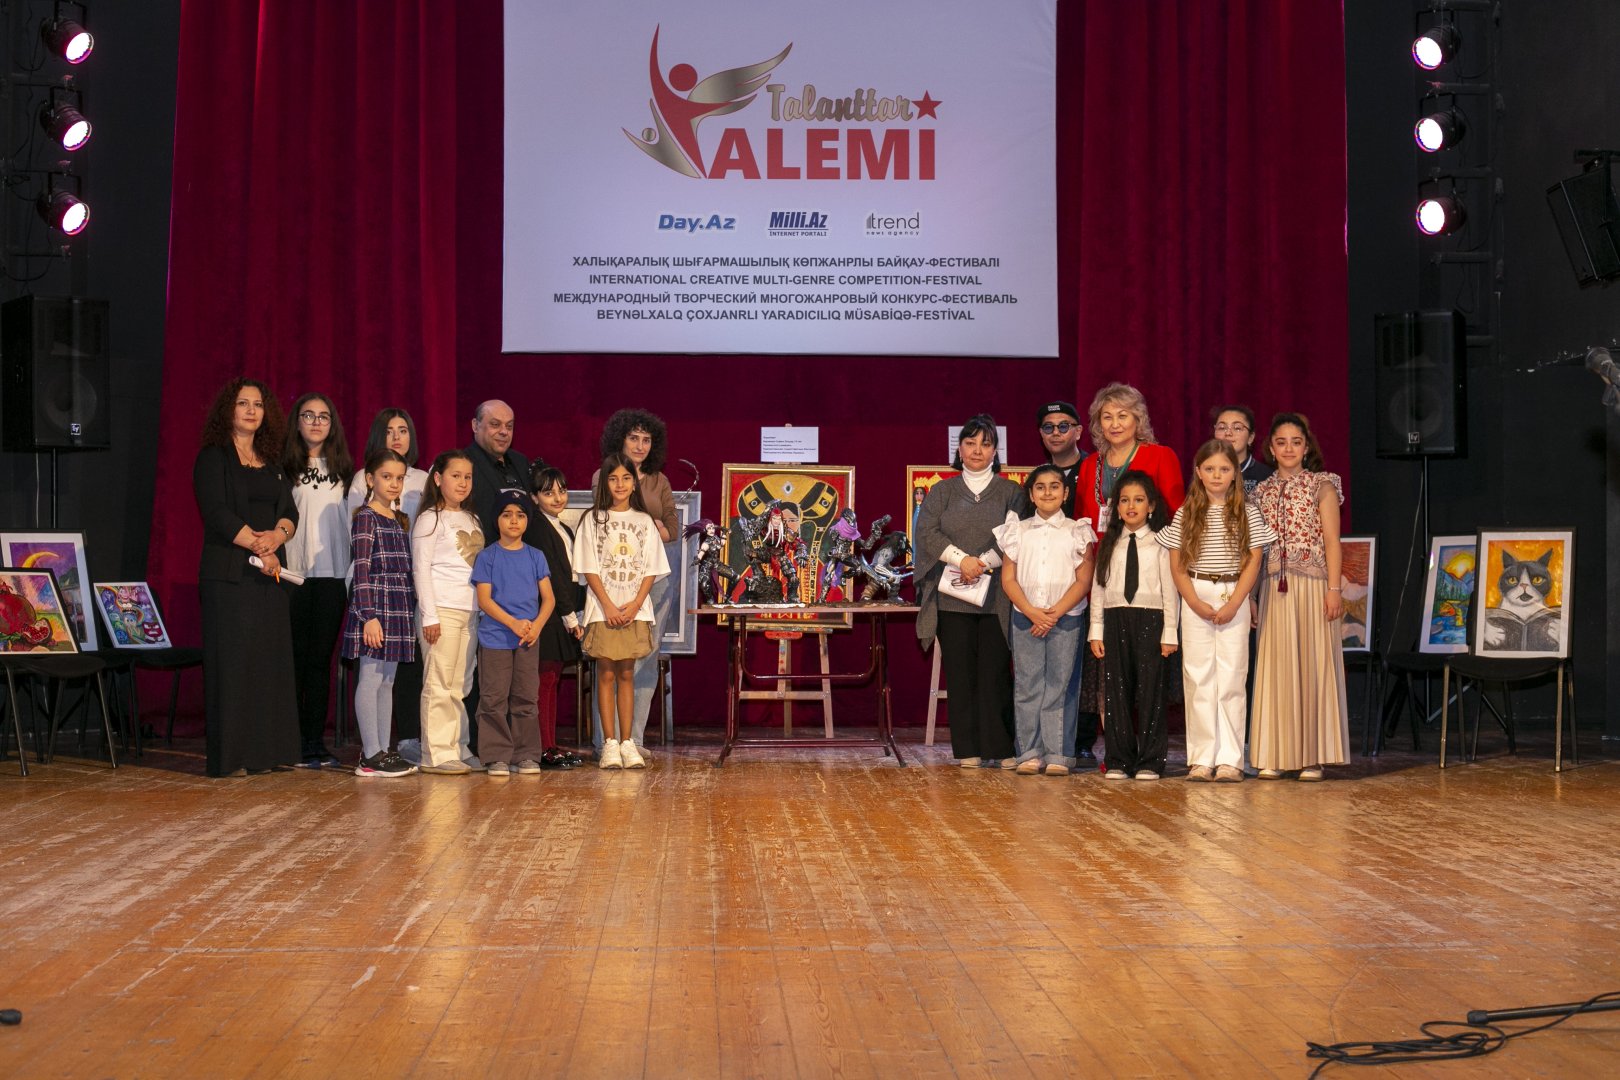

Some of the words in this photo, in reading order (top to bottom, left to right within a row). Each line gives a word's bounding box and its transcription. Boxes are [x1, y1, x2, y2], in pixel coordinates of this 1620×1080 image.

[766, 84, 913, 122] Talanttar
[707, 128, 936, 181] ALEMI
[658, 214, 737, 233] Day.Az
[769, 211, 828, 229] Milli.Az
[866, 211, 920, 230] trend
[572, 256, 670, 269] ХАЛЫҚАРАЛЫҚ
[672, 256, 790, 269] ШЫҒАРМАШЫЛЫҚ
[792, 257, 874, 268] КӨПЖАНРЛЫ
[876, 255, 1000, 269] БАЙҚАУ-ФЕСТИВАЛІ
[589, 274, 687, 285] INTERNATIONAL
[689, 274, 750, 285] CREATIVE
[752, 274, 836, 285] MULTI-GENRE
[838, 275, 983, 286] COMPETITION-FESTIVAL
[553, 291, 671, 304] МЕЖДУНАРОДНЫЙ
[674, 291, 757, 304] ТВОРЧЕСКИЙ
[760, 291, 878, 304] МНОГОЖАНРОВЫЙ
[881, 293, 1018, 304] КОНКУРС-ФЕСТИВАЛЬ
[596, 309, 683, 321] BEYNƏLXALQ
[685, 309, 758, 323] ÇOXJANRLI
[761, 309, 841, 321] YARADICILIQ
[844, 307, 976, 321] MÜSABİQƏ-FESTİVAL
